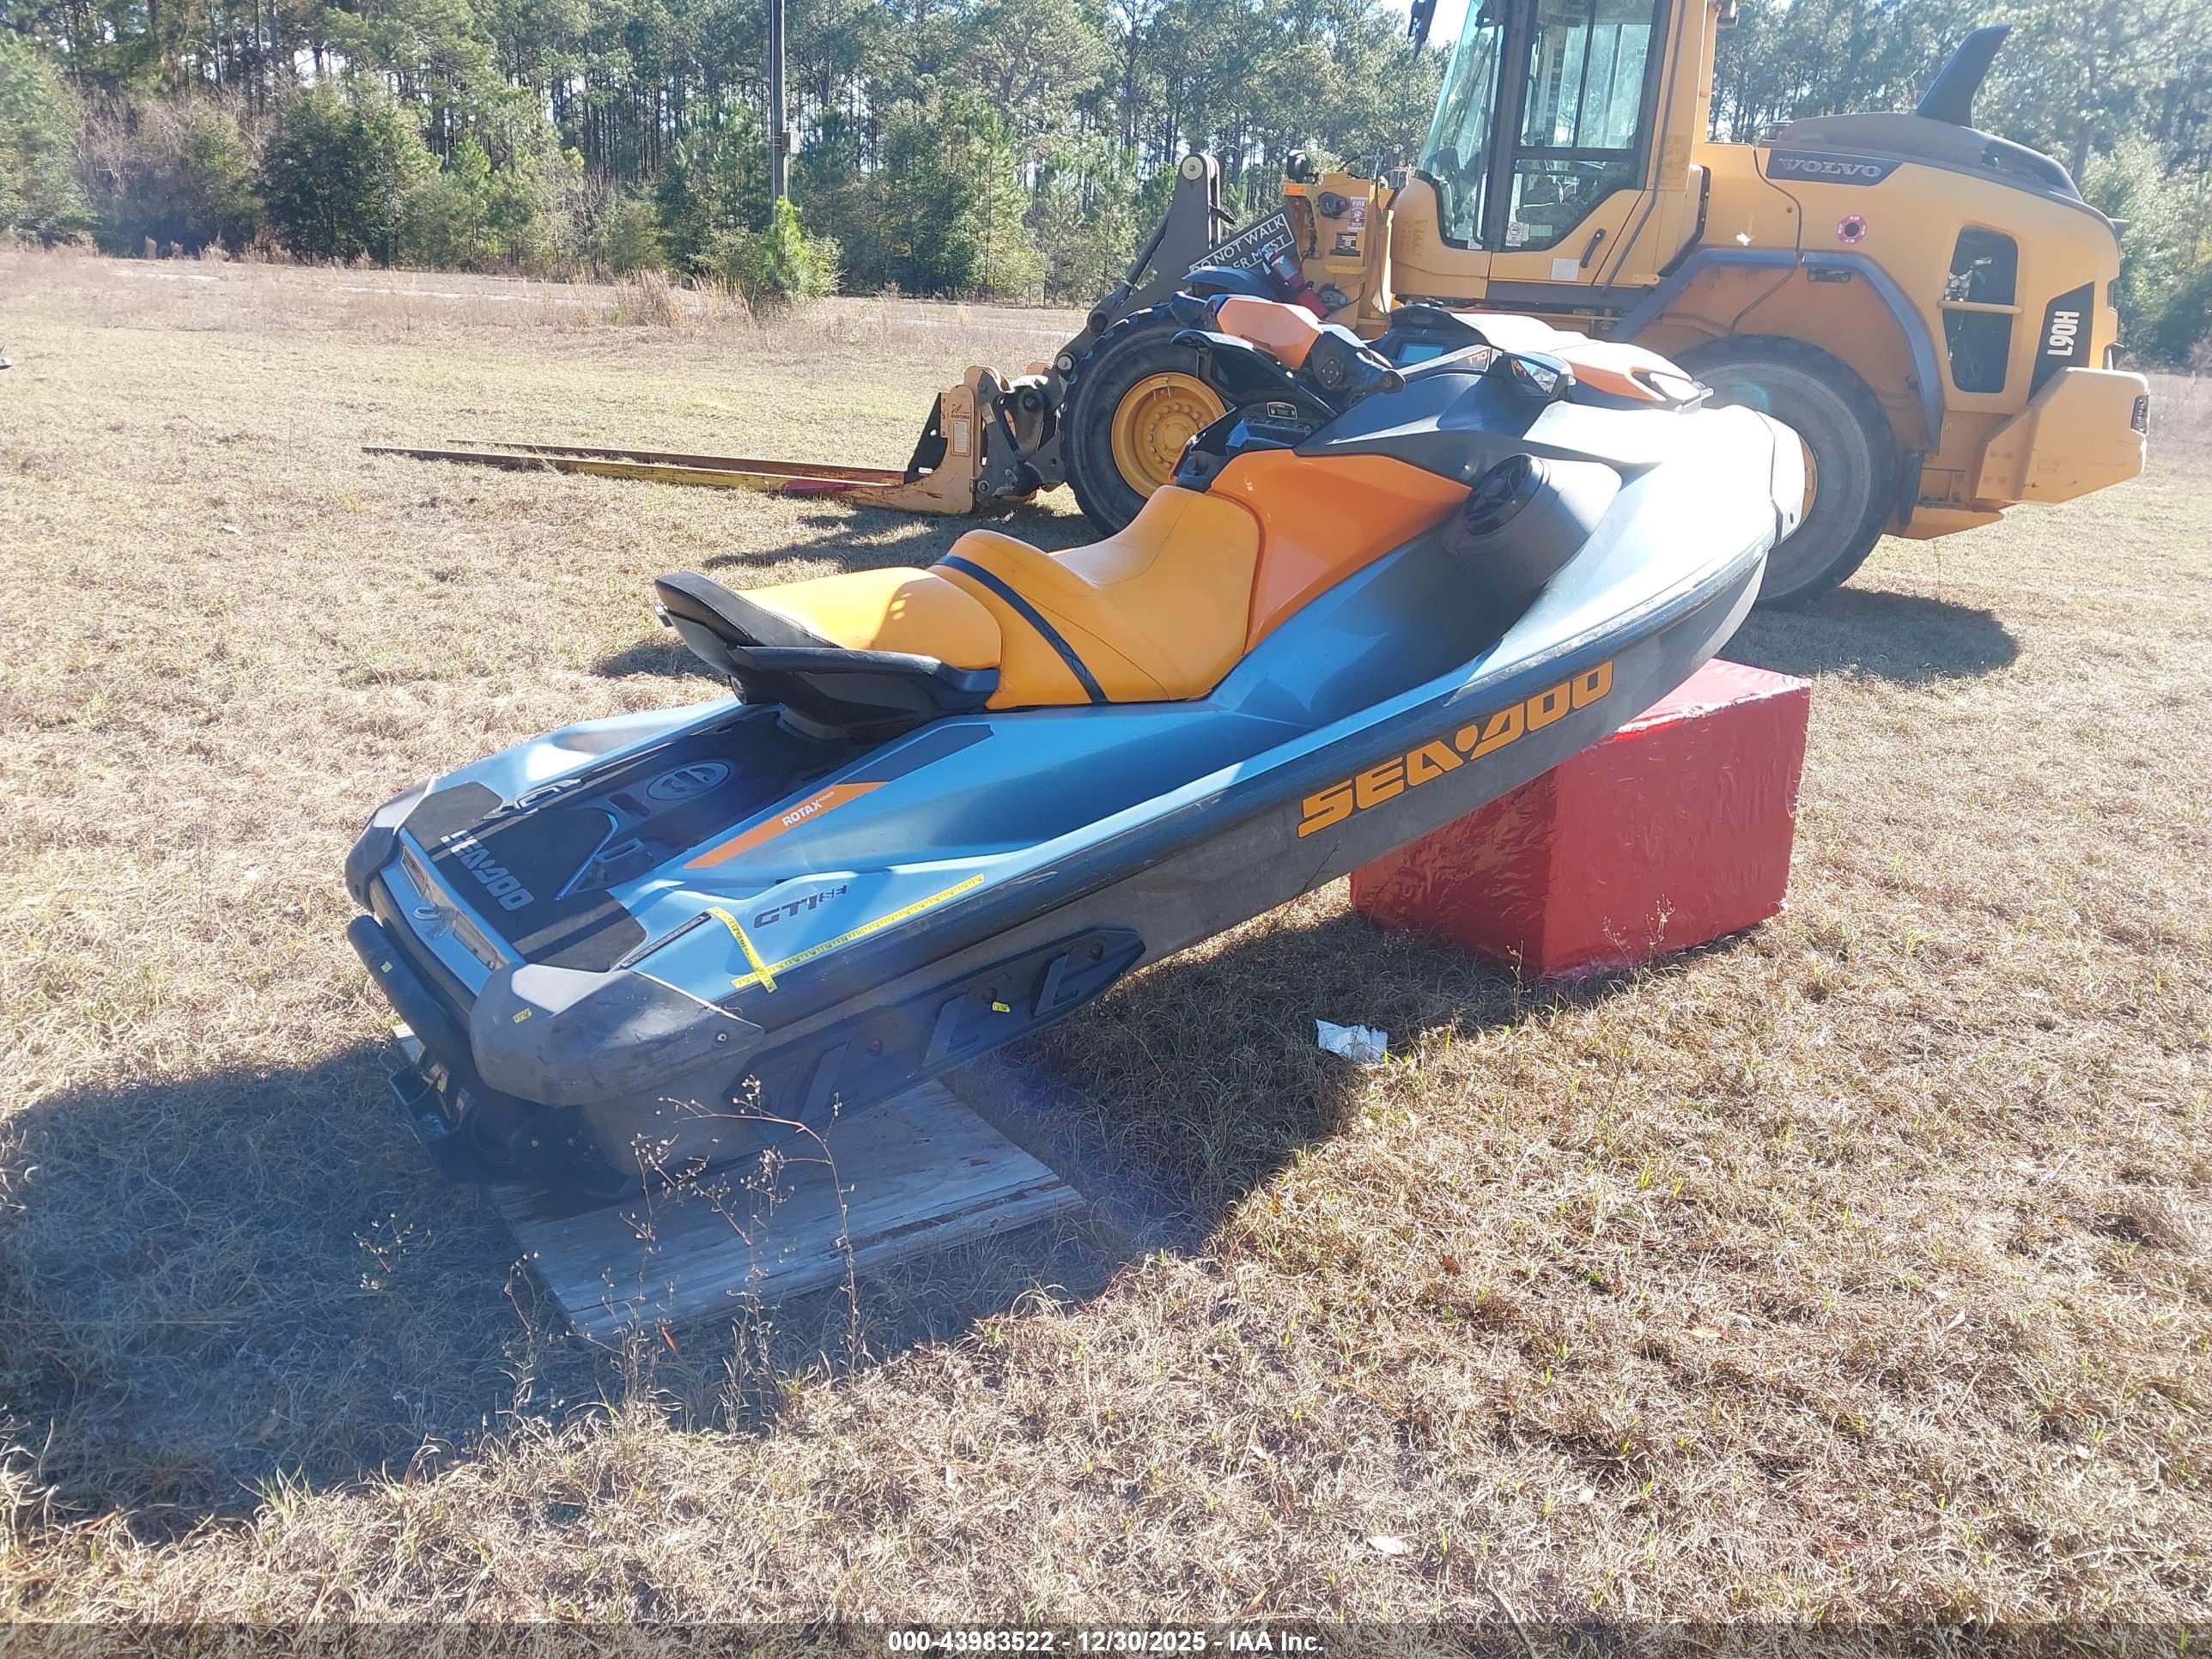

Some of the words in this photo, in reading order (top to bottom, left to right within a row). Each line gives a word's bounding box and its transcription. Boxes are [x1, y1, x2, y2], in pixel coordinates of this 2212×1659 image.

[1779, 158, 1881, 177] VOLVO
[1213, 241, 1242, 264] NOT
[1244, 216, 1285, 246] WALK
[1251, 234, 1285, 261] MST
[2047, 311, 2080, 356] L90H
[781, 799, 823, 826] ROTAX
[754, 895, 817, 928] GTI
